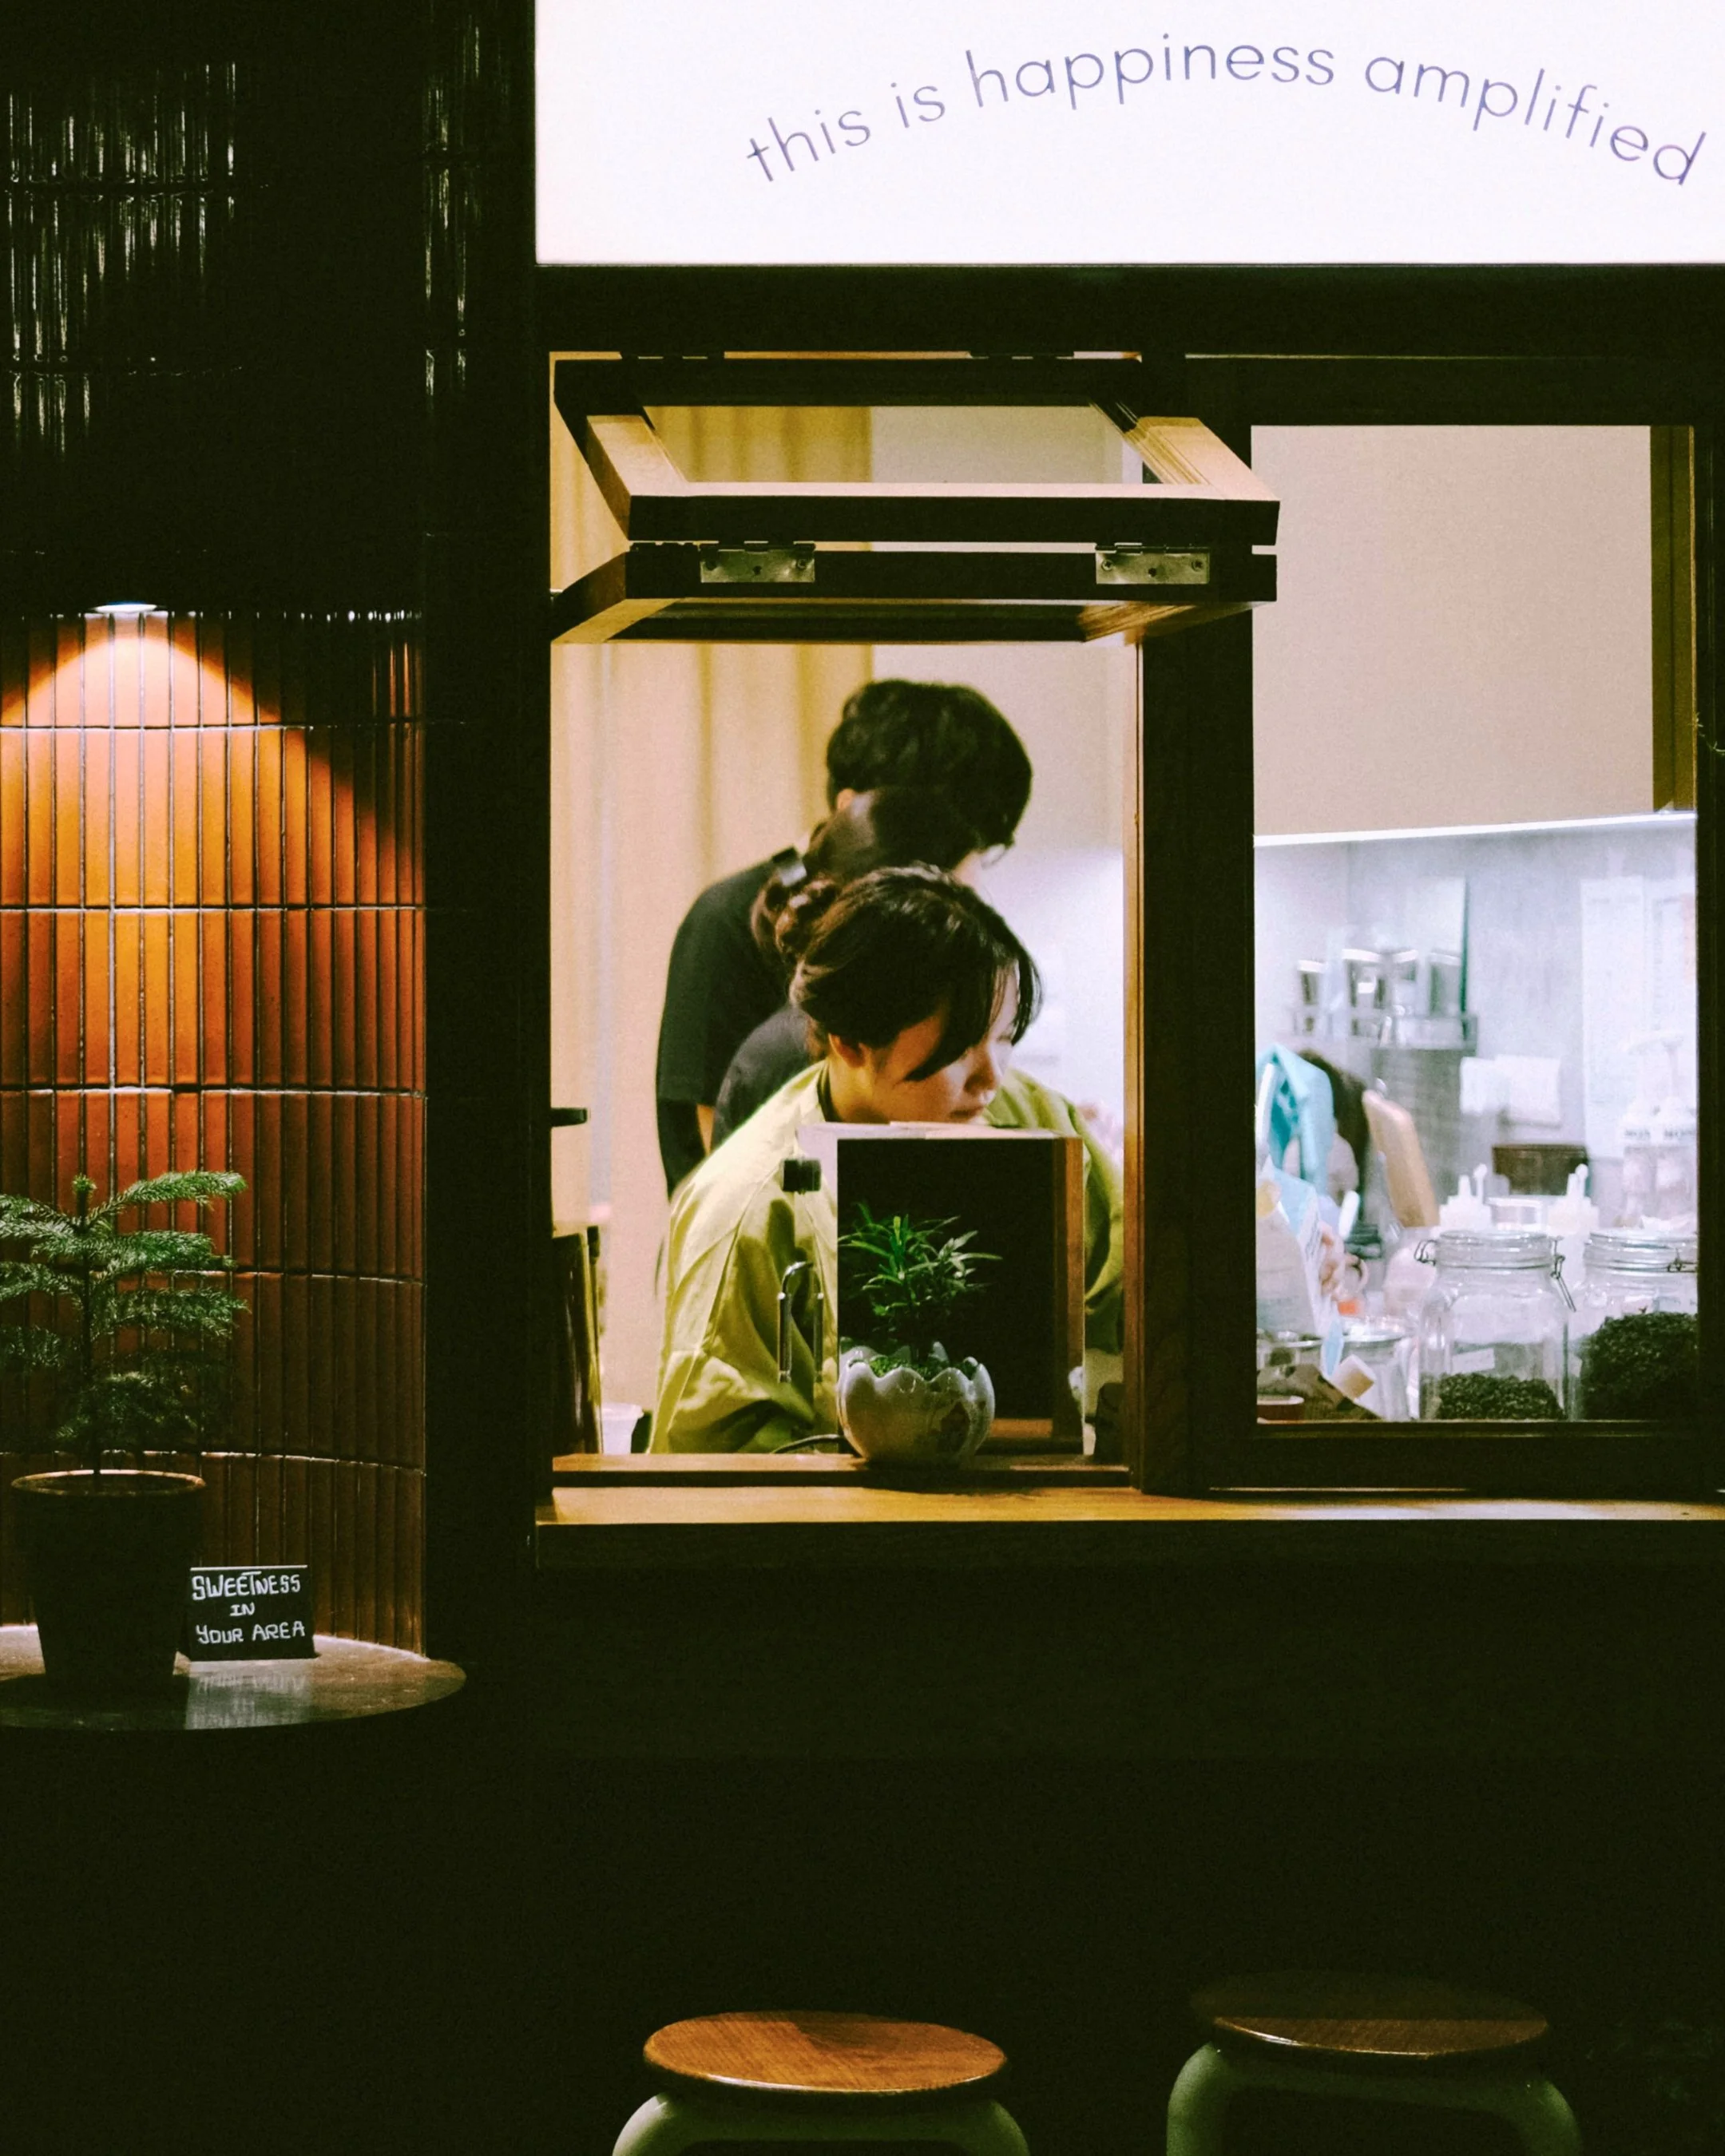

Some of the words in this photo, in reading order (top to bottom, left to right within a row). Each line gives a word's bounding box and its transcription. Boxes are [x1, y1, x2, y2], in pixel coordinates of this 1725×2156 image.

[747, 110, 870, 183] this
[890, 81, 946, 129] is
[966, 33, 1334, 110] happiness
[1365, 57, 1707, 185] amplified
[192, 1571, 300, 1600] SWEETNESS
[230, 1602, 255, 1616] IN
[196, 1624, 244, 1644] YOUR
[252, 1621, 305, 1641] AREA
